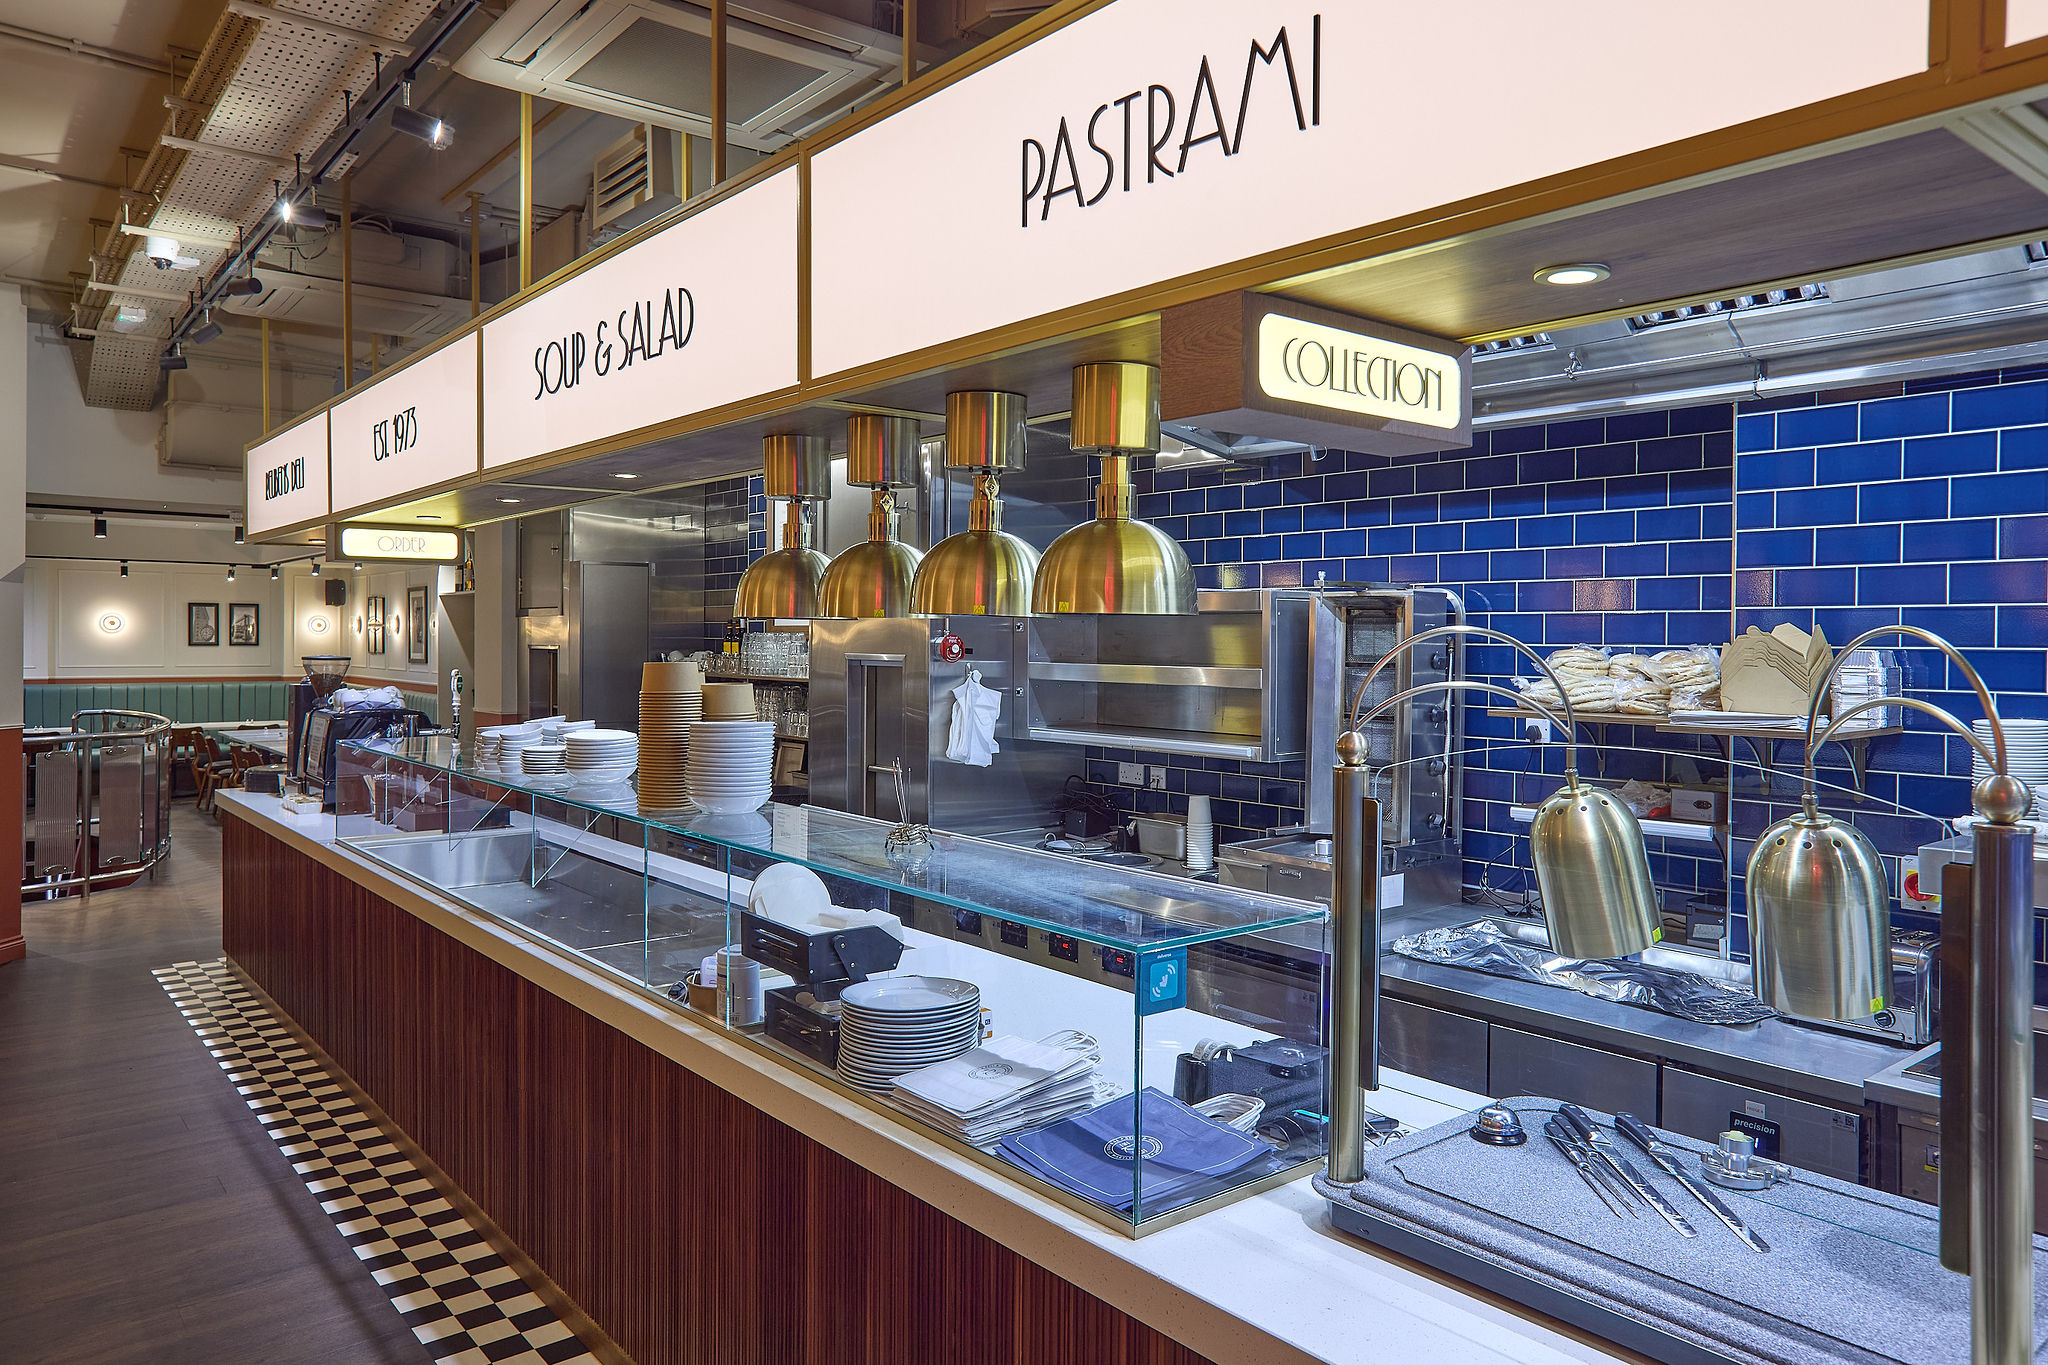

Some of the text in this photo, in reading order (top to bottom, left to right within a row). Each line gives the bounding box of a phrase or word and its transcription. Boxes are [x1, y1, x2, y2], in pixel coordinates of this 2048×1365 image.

[1021, 14, 1321, 228] PASTRAMI
[534, 287, 695, 401] SOUP & SALAD
[1282, 337, 1442, 411] COLLECTION
[373, 406, 418, 461] EST. 1973
[290, 456, 305, 492] DELI
[377, 535, 426, 553] ORDER
[1734, 1118, 1776, 1135] precision
